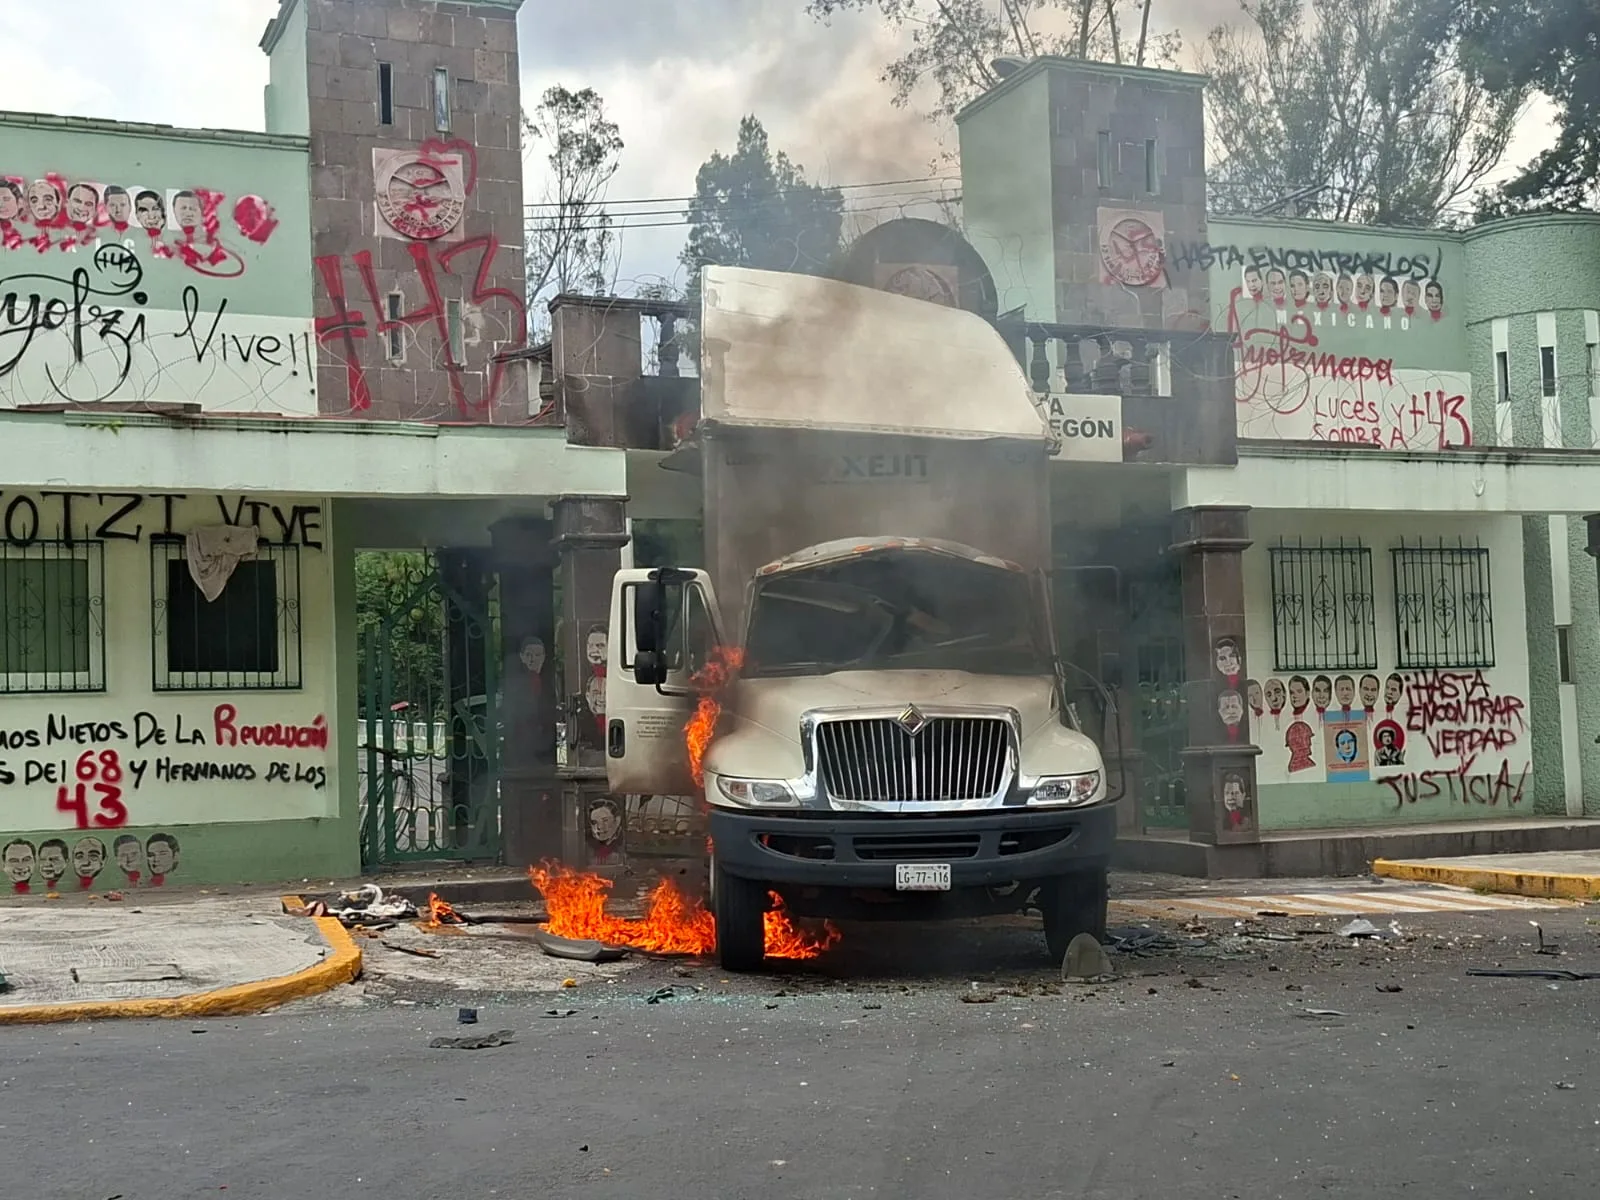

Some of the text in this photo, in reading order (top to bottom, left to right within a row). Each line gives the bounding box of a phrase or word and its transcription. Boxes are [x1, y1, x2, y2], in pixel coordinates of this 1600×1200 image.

[1169, 243, 1244, 272] HASTA
[0, 490, 187, 549] OTZI
[1406, 696, 1526, 734] ENCONTRAR
[1427, 727, 1516, 759] VERDAD
[76, 750, 123, 783] 68
[57, 782, 128, 829] 43
[898, 871, 949, 884] LG-77-116
